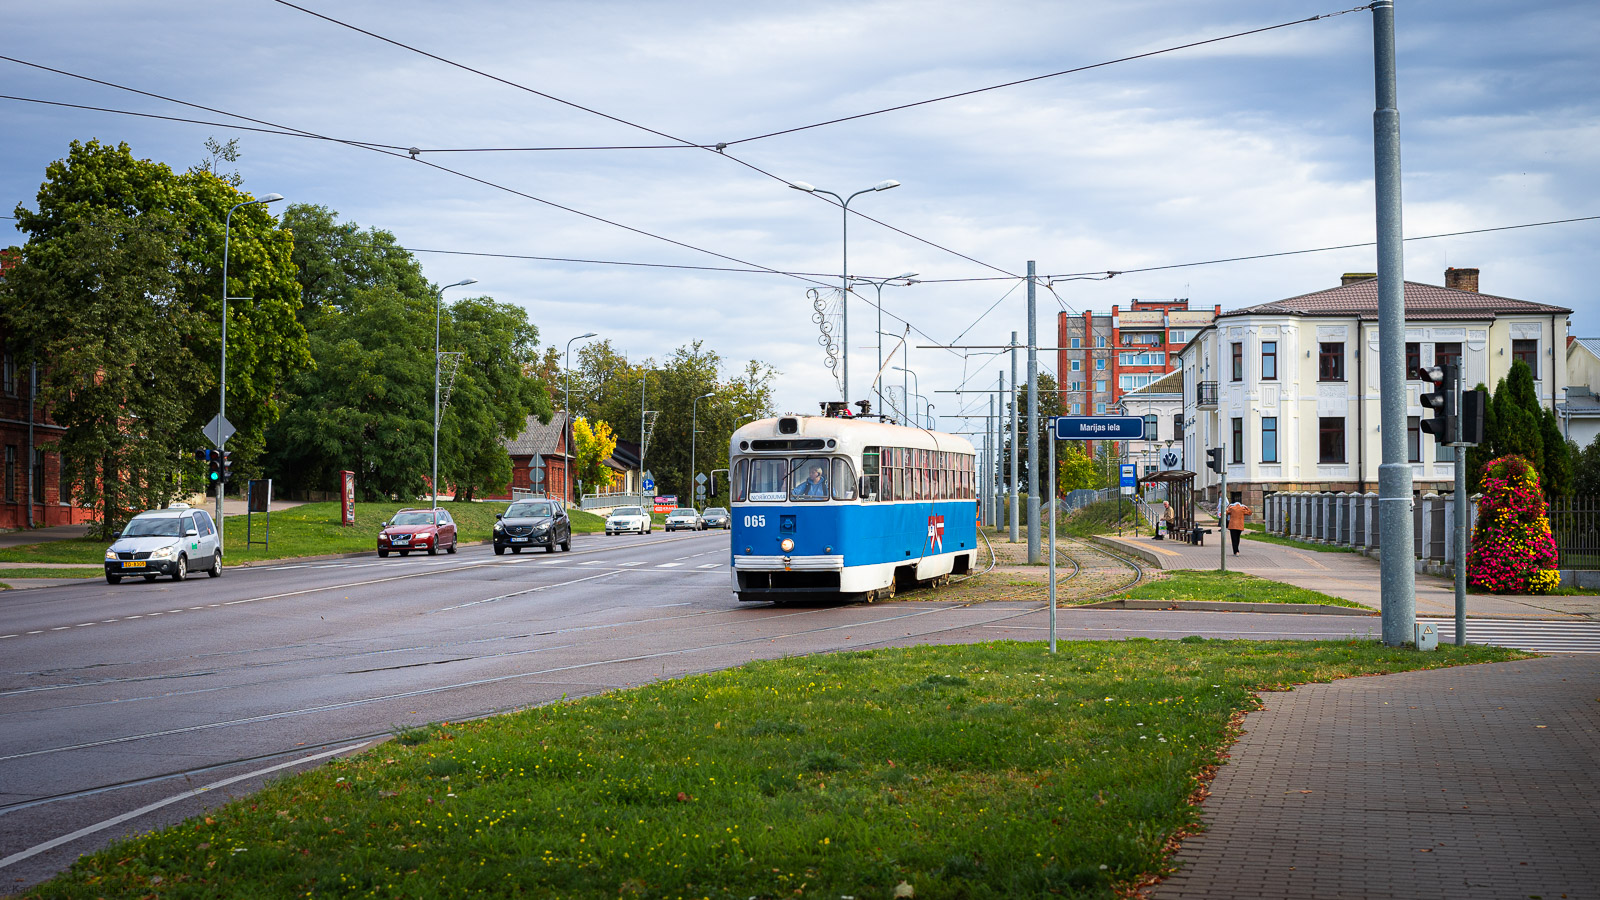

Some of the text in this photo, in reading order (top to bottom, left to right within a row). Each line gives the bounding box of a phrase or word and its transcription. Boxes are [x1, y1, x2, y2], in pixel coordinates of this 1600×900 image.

[1080, 423, 1121, 433] Marijas iela
[744, 515, 766, 528] 065
